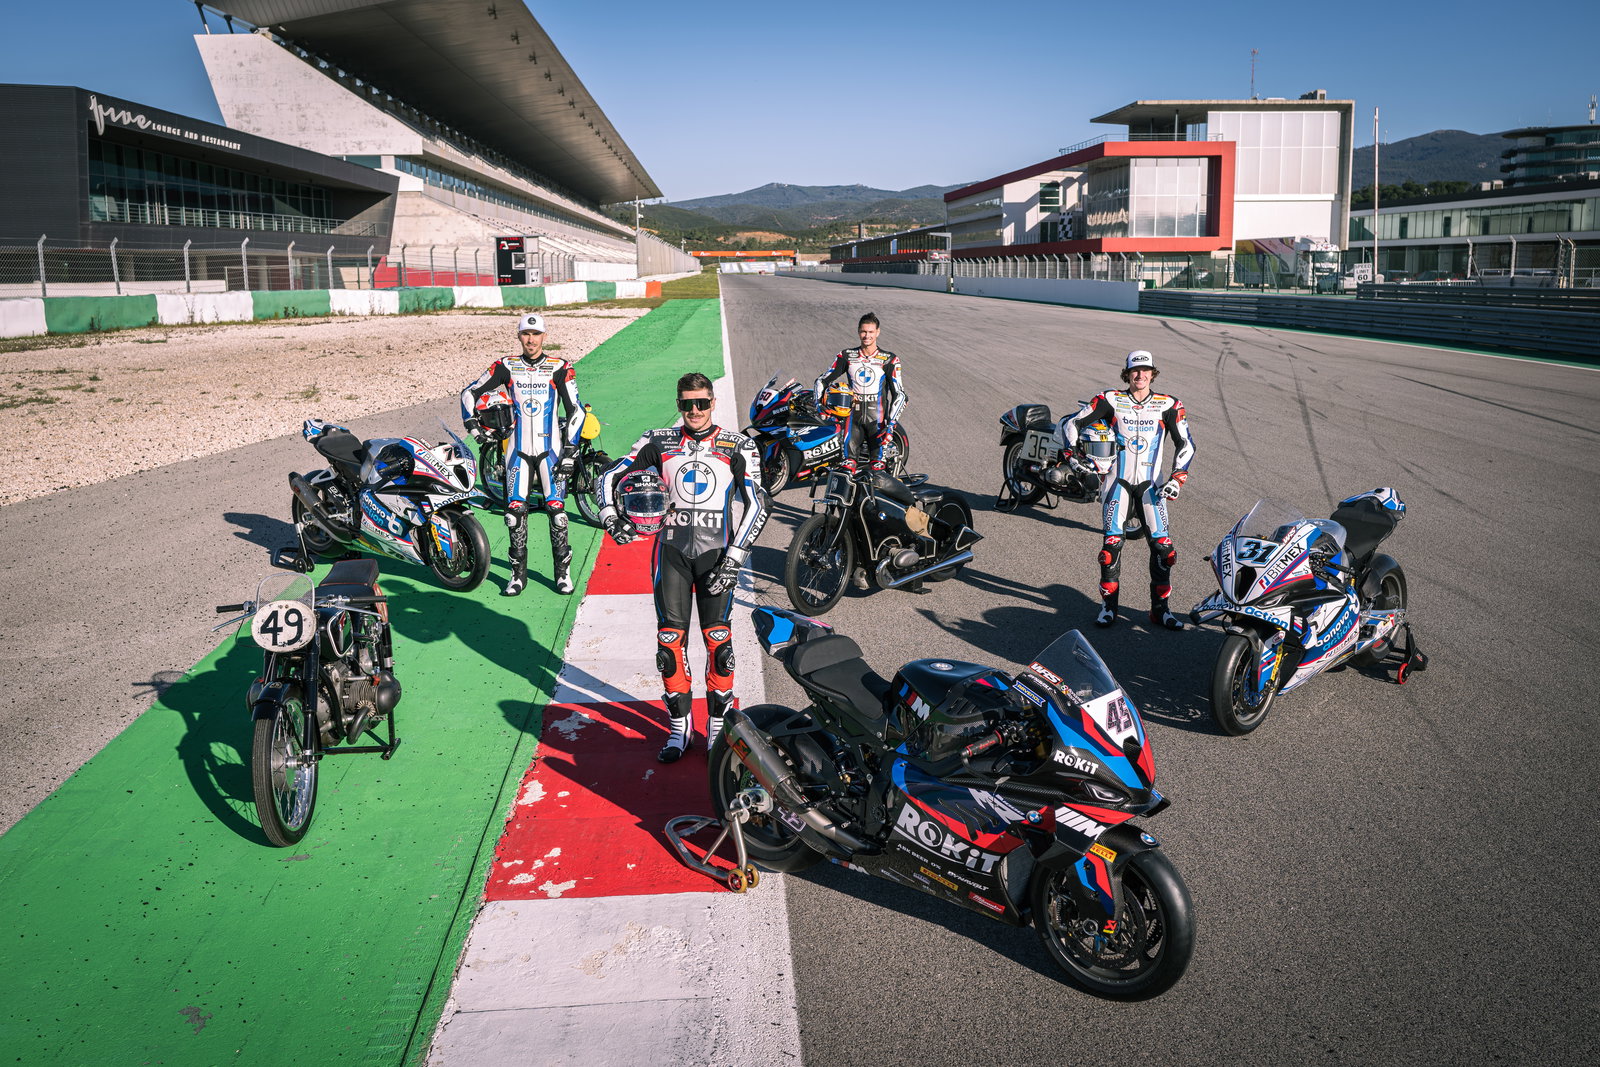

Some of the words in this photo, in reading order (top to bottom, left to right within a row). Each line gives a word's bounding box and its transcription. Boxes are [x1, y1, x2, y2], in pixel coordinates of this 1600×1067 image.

[152, 122, 181, 136] LOUNGE
[184, 130, 198, 140] AND
[201, 135, 242, 150] RESTAURANT
[516, 380, 547, 388] bonovo
[1122, 416, 1154, 426] bonovo
[1028, 434, 1050, 460] 36
[680, 463, 712, 475] BMW
[1222, 540, 1232, 578] BitMEX
[1238, 541, 1278, 564] 31
[1267, 542, 1306, 579] BitMEX
[260, 608, 303, 646] 49
[1244, 606, 1288, 629] action
[1030, 662, 1060, 684] WRS
[1017, 684, 1040, 702] RAVENOL
[1054, 750, 1098, 774] ROKiT
[897, 802, 1001, 873] ROKiT
[912, 850, 929, 864] BEER
